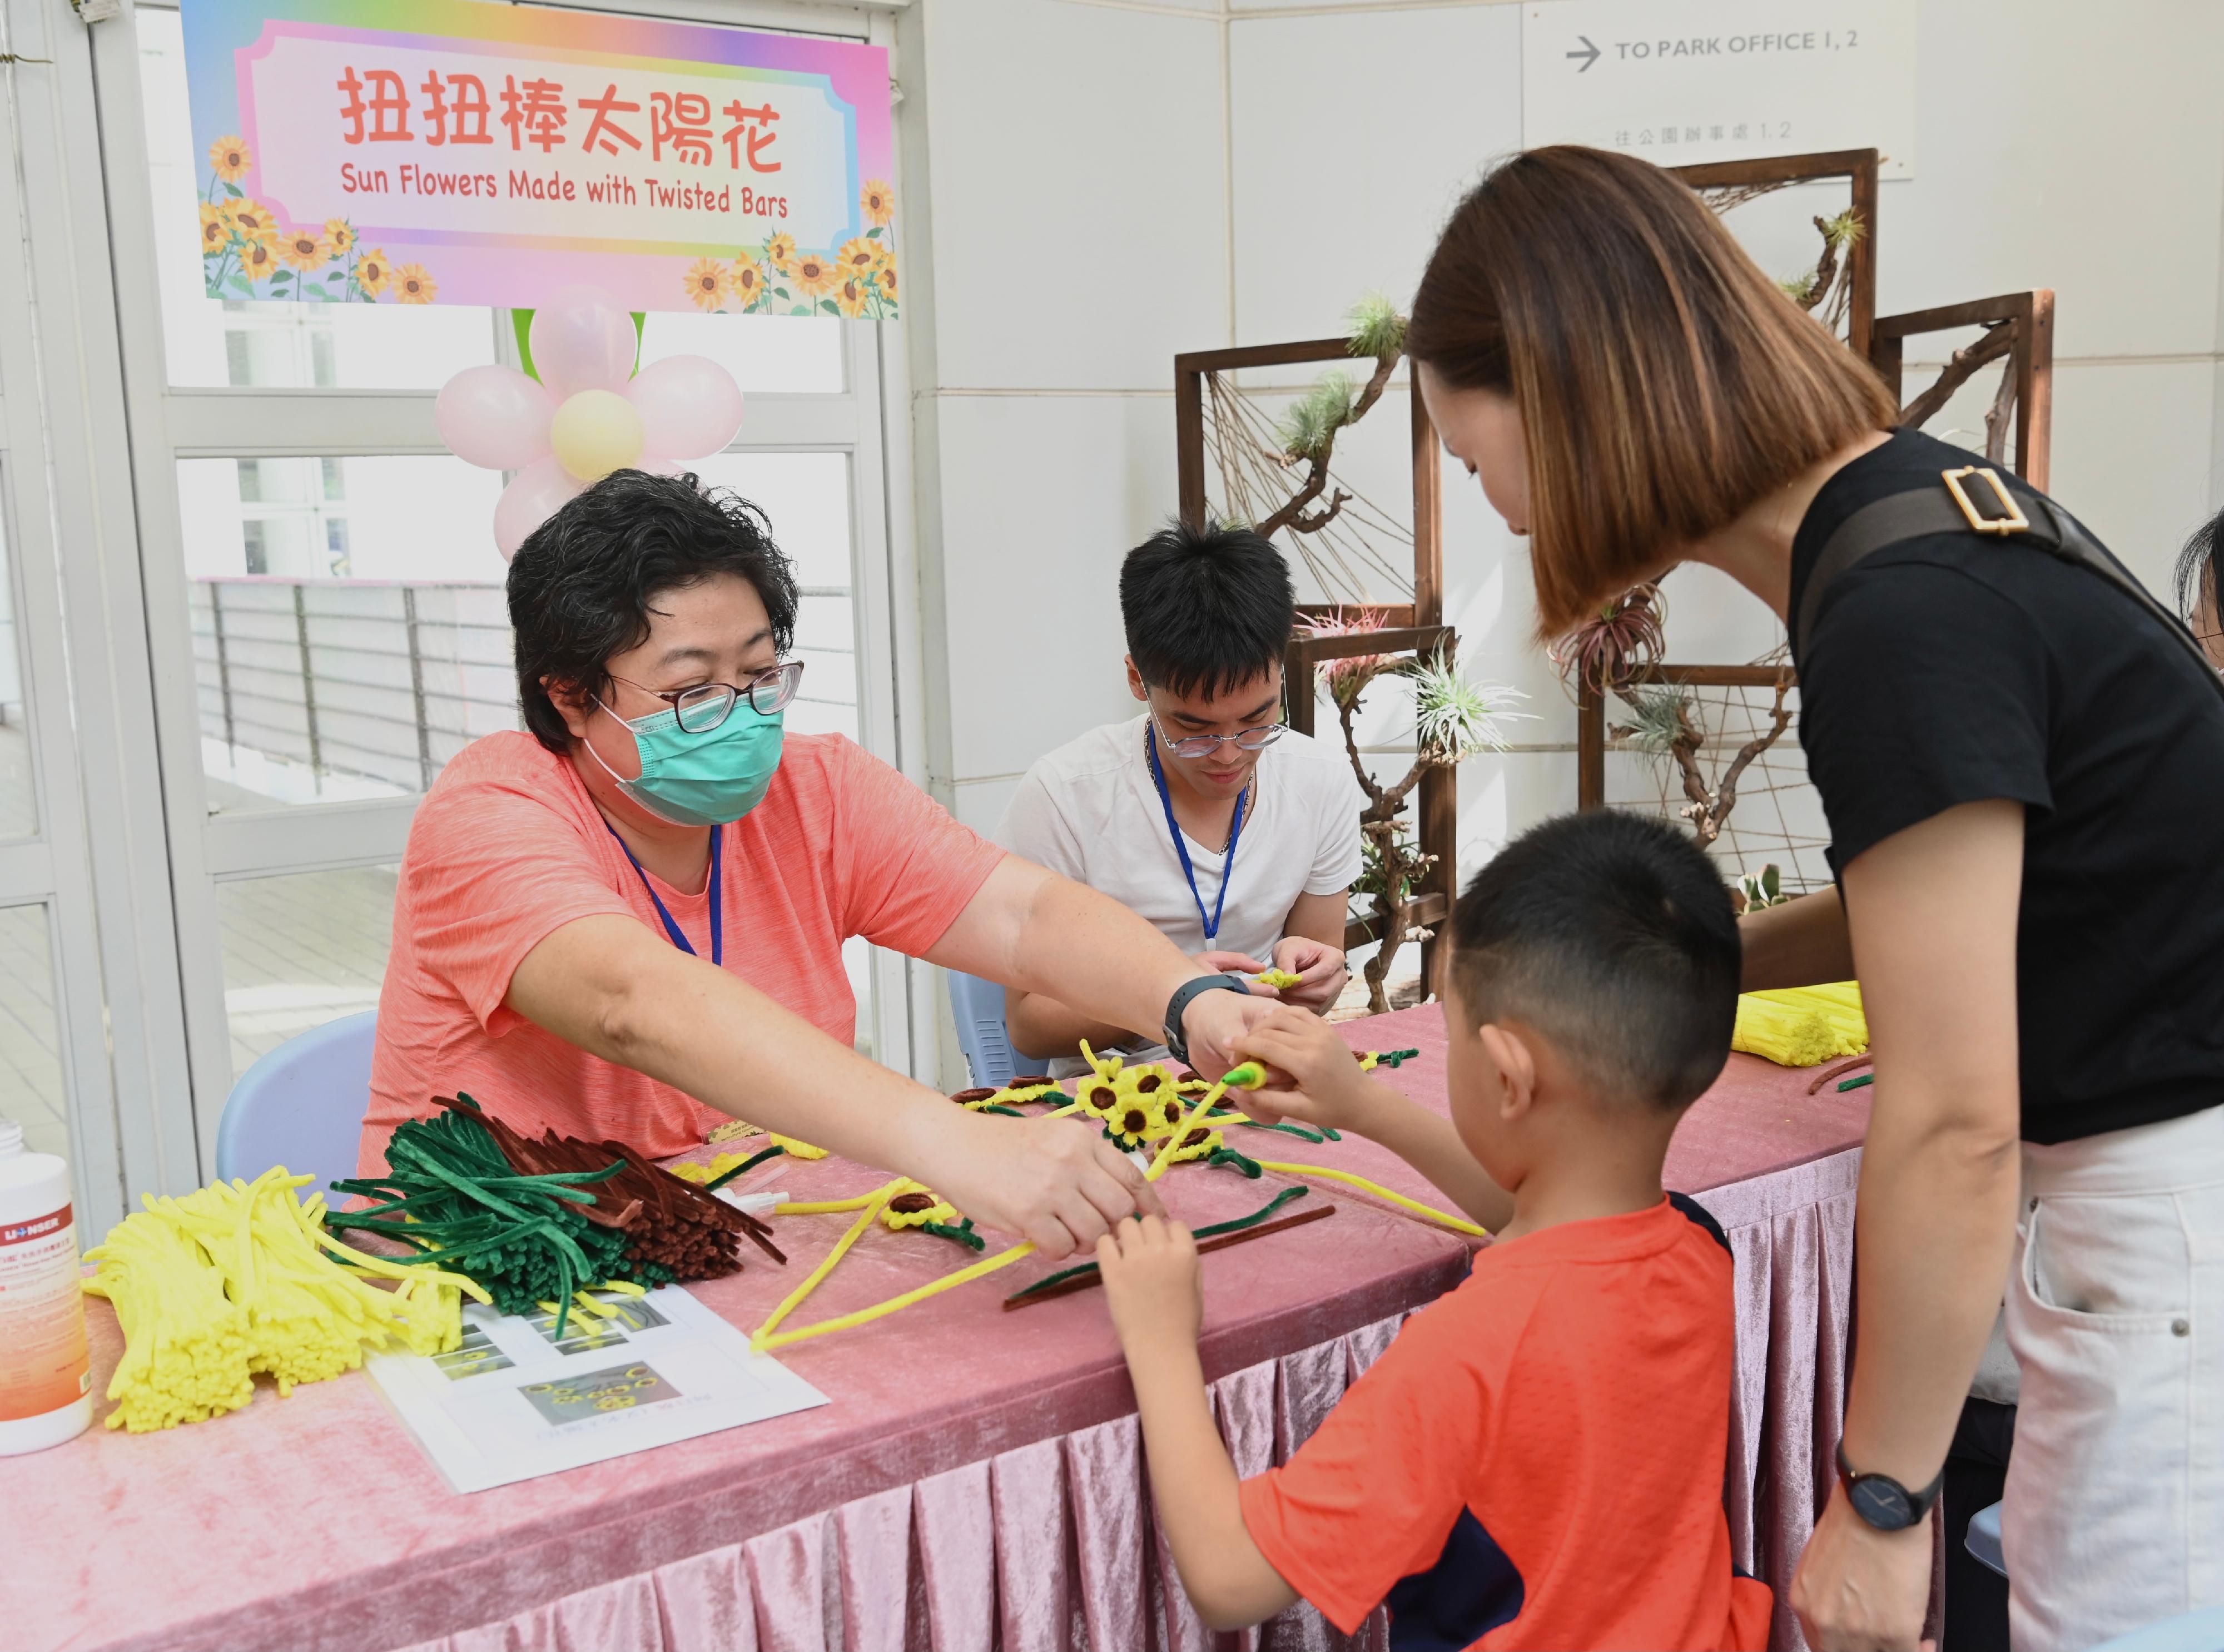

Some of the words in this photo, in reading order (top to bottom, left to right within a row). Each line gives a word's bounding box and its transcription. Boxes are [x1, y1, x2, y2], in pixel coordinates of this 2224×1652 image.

[1615, 42, 1650, 59] TO
[1657, 37, 1722, 57] PARK
[1728, 32, 1815, 53] OFFICE
[337, 66, 782, 173] 扭扭棒太陽花
[341, 162, 389, 194] Sun
[399, 163, 497, 197] Flowers
[509, 169, 576, 201] Made
[586, 173, 636, 206] with
[644, 178, 730, 213] Twisted
[741, 186, 788, 219] Bars
